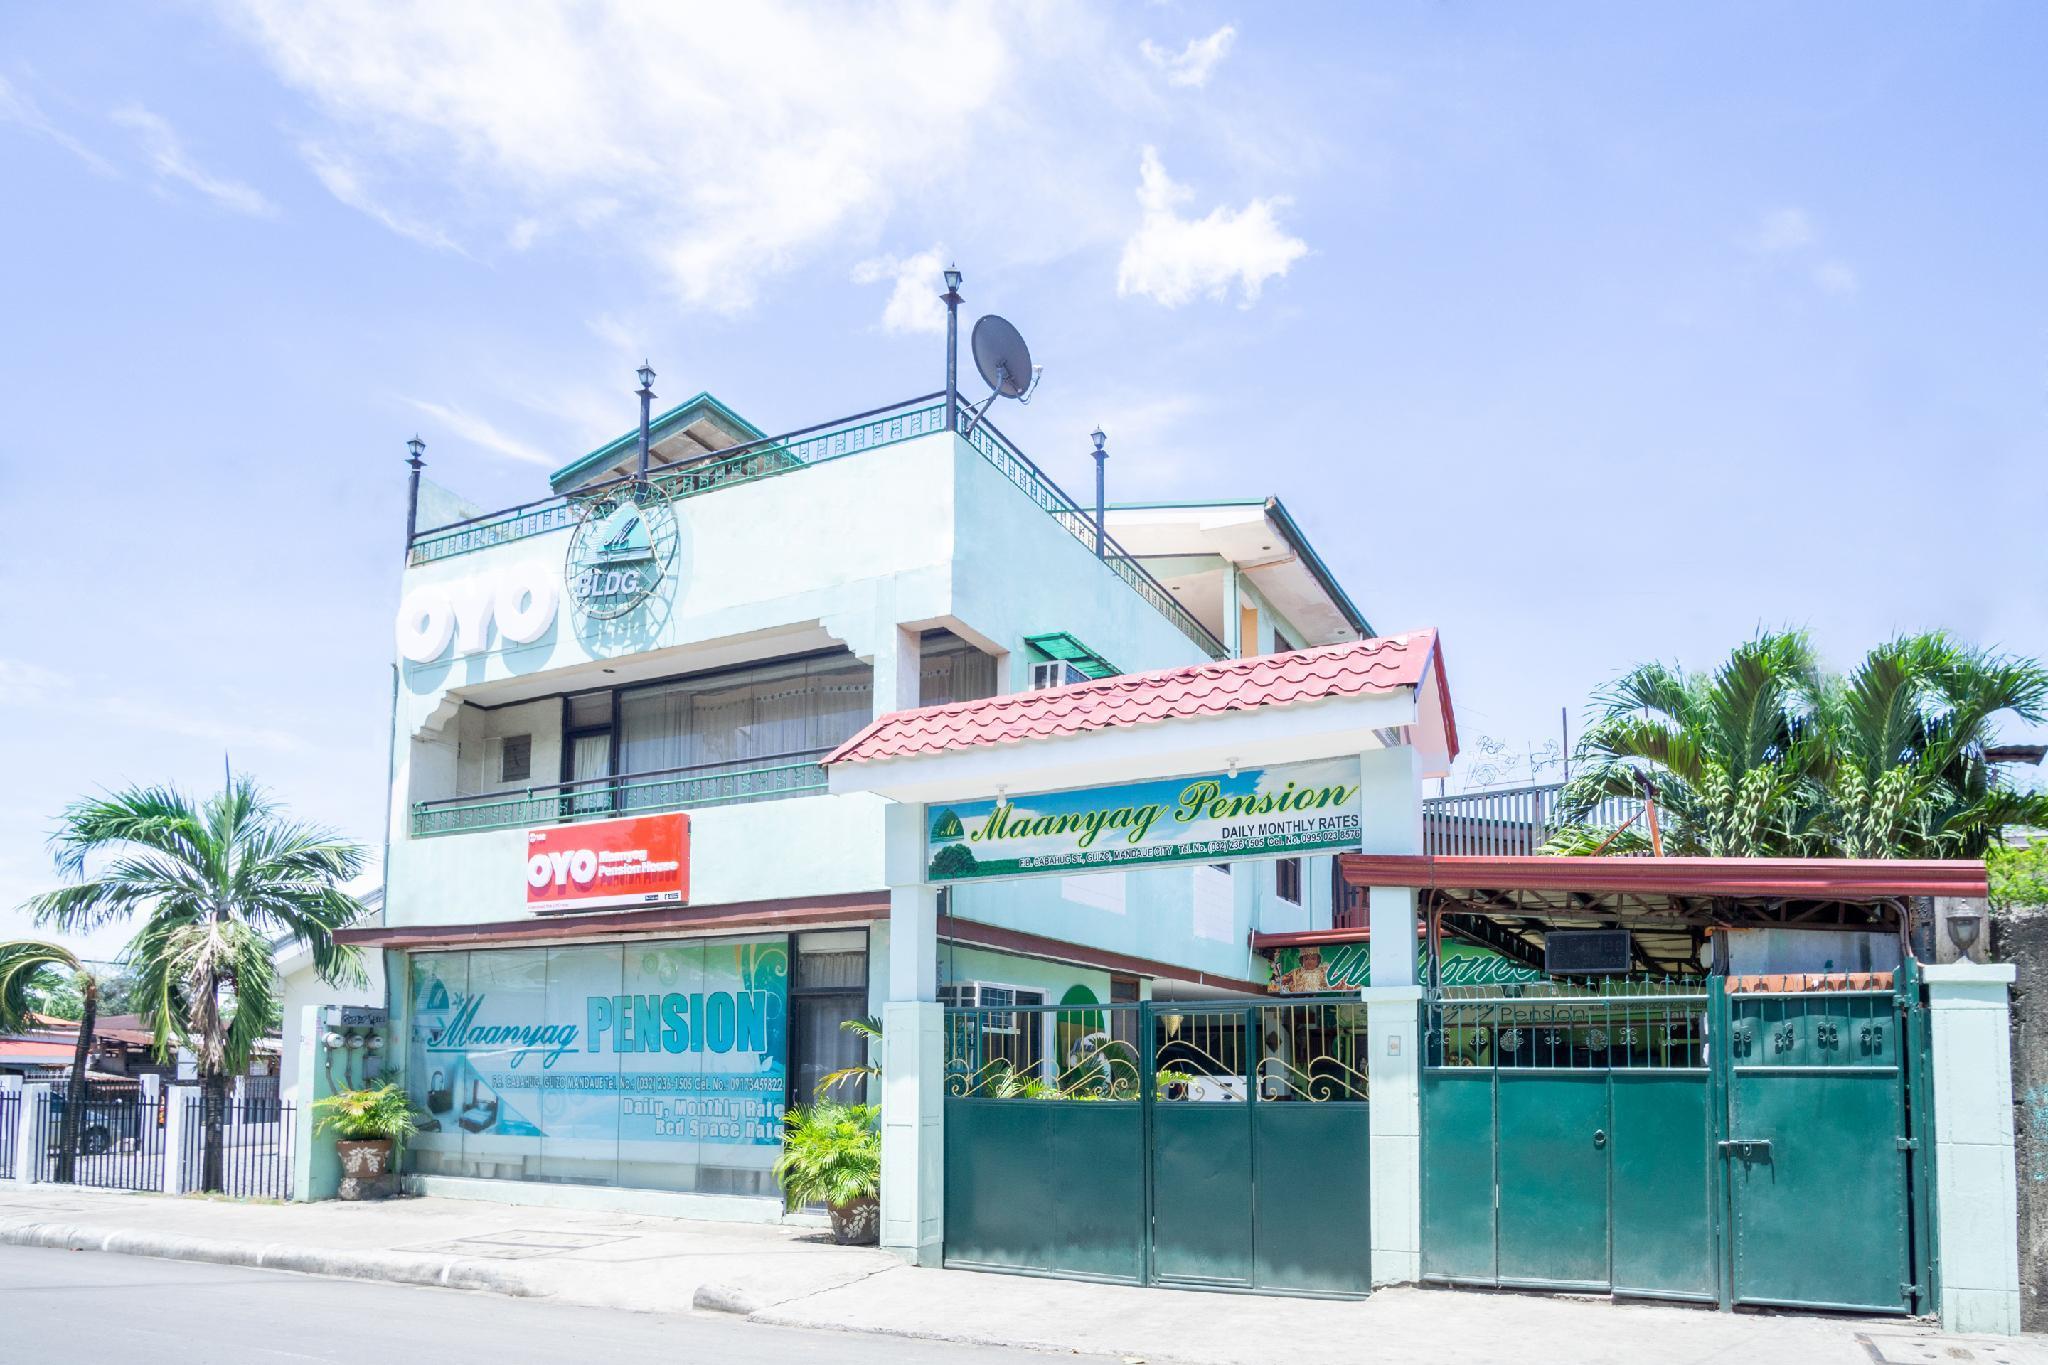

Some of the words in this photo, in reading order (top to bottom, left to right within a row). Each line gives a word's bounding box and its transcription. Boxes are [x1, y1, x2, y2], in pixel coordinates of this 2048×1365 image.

[576, 569, 643, 598] BLDG.
[395, 562, 561, 664] OYO
[970, 802, 1168, 848] Maanyag
[1174, 780, 1360, 823] Pension
[1222, 824, 1255, 839] DAILY
[1258, 818, 1315, 836] MONTHLY
[1318, 814, 1359, 830] RATES
[1034, 854, 1071, 866] CABAHUG
[1114, 847, 1152, 860] MANDAUE
[1152, 845, 1173, 856] CITY
[1208, 840, 1229, 854] (032)
[1229, 839, 1244, 850] 236
[1246, 837, 1265, 848] 1505
[1286, 834, 1300, 844] No.
[1302, 832, 1322, 843] 0995
[1323, 830, 1338, 842] 023
[1340, 828, 1360, 840] 8576
[527, 849, 598, 888] OYO
[598, 862, 642, 877] Pension
[642, 861, 679, 874] House
[1500, 1005, 1586, 1023] Pension
[426, 993, 579, 1070] Maanyag
[586, 990, 767, 1055] PENSION
[543, 1075, 567, 1089] GUIZO
[568, 1076, 604, 1090] MANDAUE
[657, 1077, 692, 1091] 236-1505
[623, 1097, 670, 1119] Daily,
[674, 1098, 741, 1121] Monthly
[655, 1118, 686, 1136] Bed
[689, 1119, 741, 1139] Space
